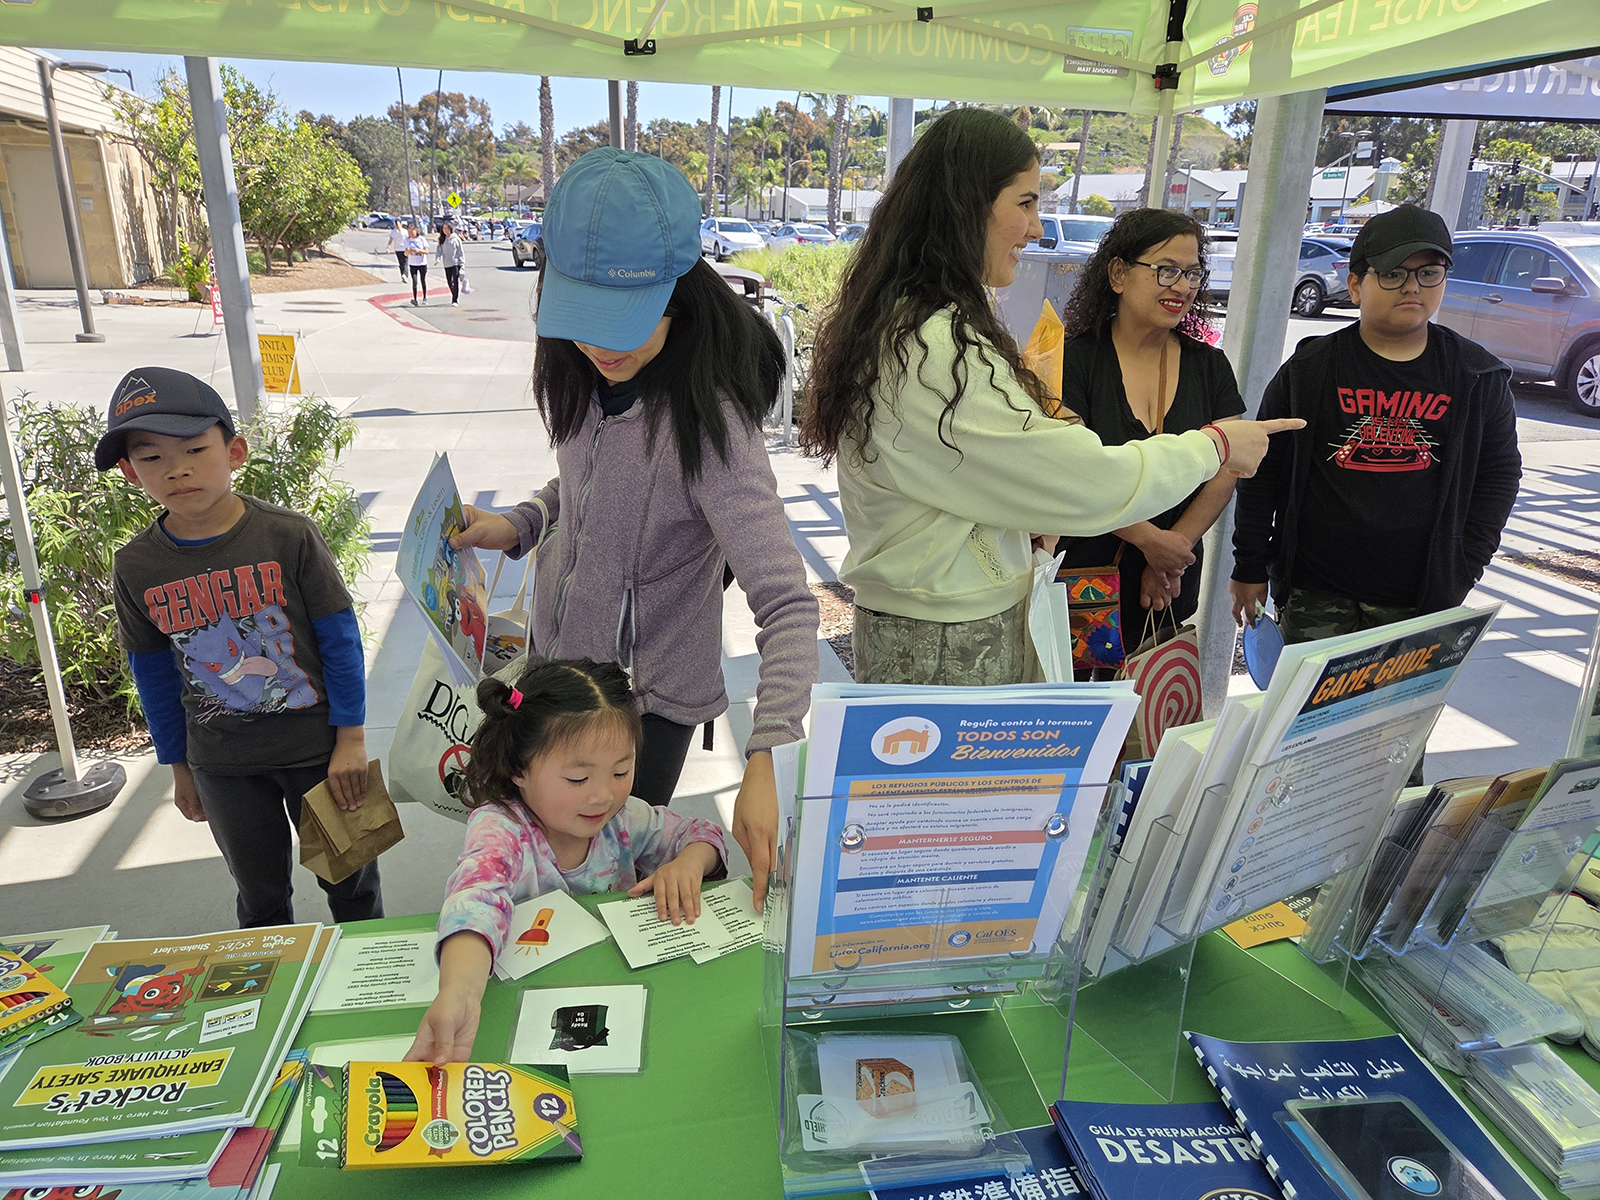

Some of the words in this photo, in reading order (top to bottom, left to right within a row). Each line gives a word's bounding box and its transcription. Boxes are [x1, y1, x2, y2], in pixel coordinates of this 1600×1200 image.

[617, 268, 656, 278] Columbia
[259, 340, 288, 351] ONITA
[261, 353, 294, 364] TIMISTS
[262, 366, 285, 376] CLUB
[115, 394, 157, 417] apex
[1337, 387, 1451, 420] GAMING
[1386, 417, 1409, 427] MY
[1358, 425, 1421, 445] VALENTINE
[144, 561, 287, 634] GENGAR
[1312, 662, 1379, 705] GAME
[1373, 643, 1441, 684] GUIDE
[422, 679, 476, 746] DIG
[960, 719, 998, 728] Regufio
[1036, 718, 1045, 726] la
[957, 731, 1017, 742] TODOS
[1021, 730, 1060, 740] SON
[950, 743, 1081, 760] Bienvenidos
[897, 876, 939, 884] MANTENTE
[1287, 897, 1311, 910] GUID
[1243, 912, 1274, 923] GUIDE
[975, 930, 995, 938] Cal
[1248, 921, 1284, 932] QUICK
[262, 937, 296, 949] Shake
[1, 996, 45, 1018] Cray
[43, 1012, 69, 1026] 12
[85, 1056, 124, 1067] BOOK
[127, 1048, 192, 1062] ACTIVITY
[105, 1059, 225, 1083] EARTHQUAKE
[1218, 1054, 1297, 1082] لمواجهة
[1301, 1059, 1360, 1082] التأهب
[1366, 1057, 1406, 1080] دليل
[30, 1070, 101, 1090] SAFETY
[49, 1081, 187, 1114] Rocket's
[305, 1072, 314, 1107] Pre-Sharpened
[437, 1088, 444, 1096] by
[1299, 1084, 1369, 1103] الكوارث
[126, 1111, 150, 1119] Hero
[363, 1077, 381, 1147] Crayola
[464, 1065, 492, 1156] COLORED
[487, 1070, 517, 1150] PENCILS
[540, 1098, 559, 1116] 12
[37, 1118, 90, 1127] Foundation
[1088, 1123, 1126, 1137] GUÍA
[1129, 1128, 1146, 1137] DE
[1147, 1122, 1240, 1137] PREPARACIÓN
[316, 1137, 339, 1160] 12
[1096, 1138, 1263, 1165] DESASTR
